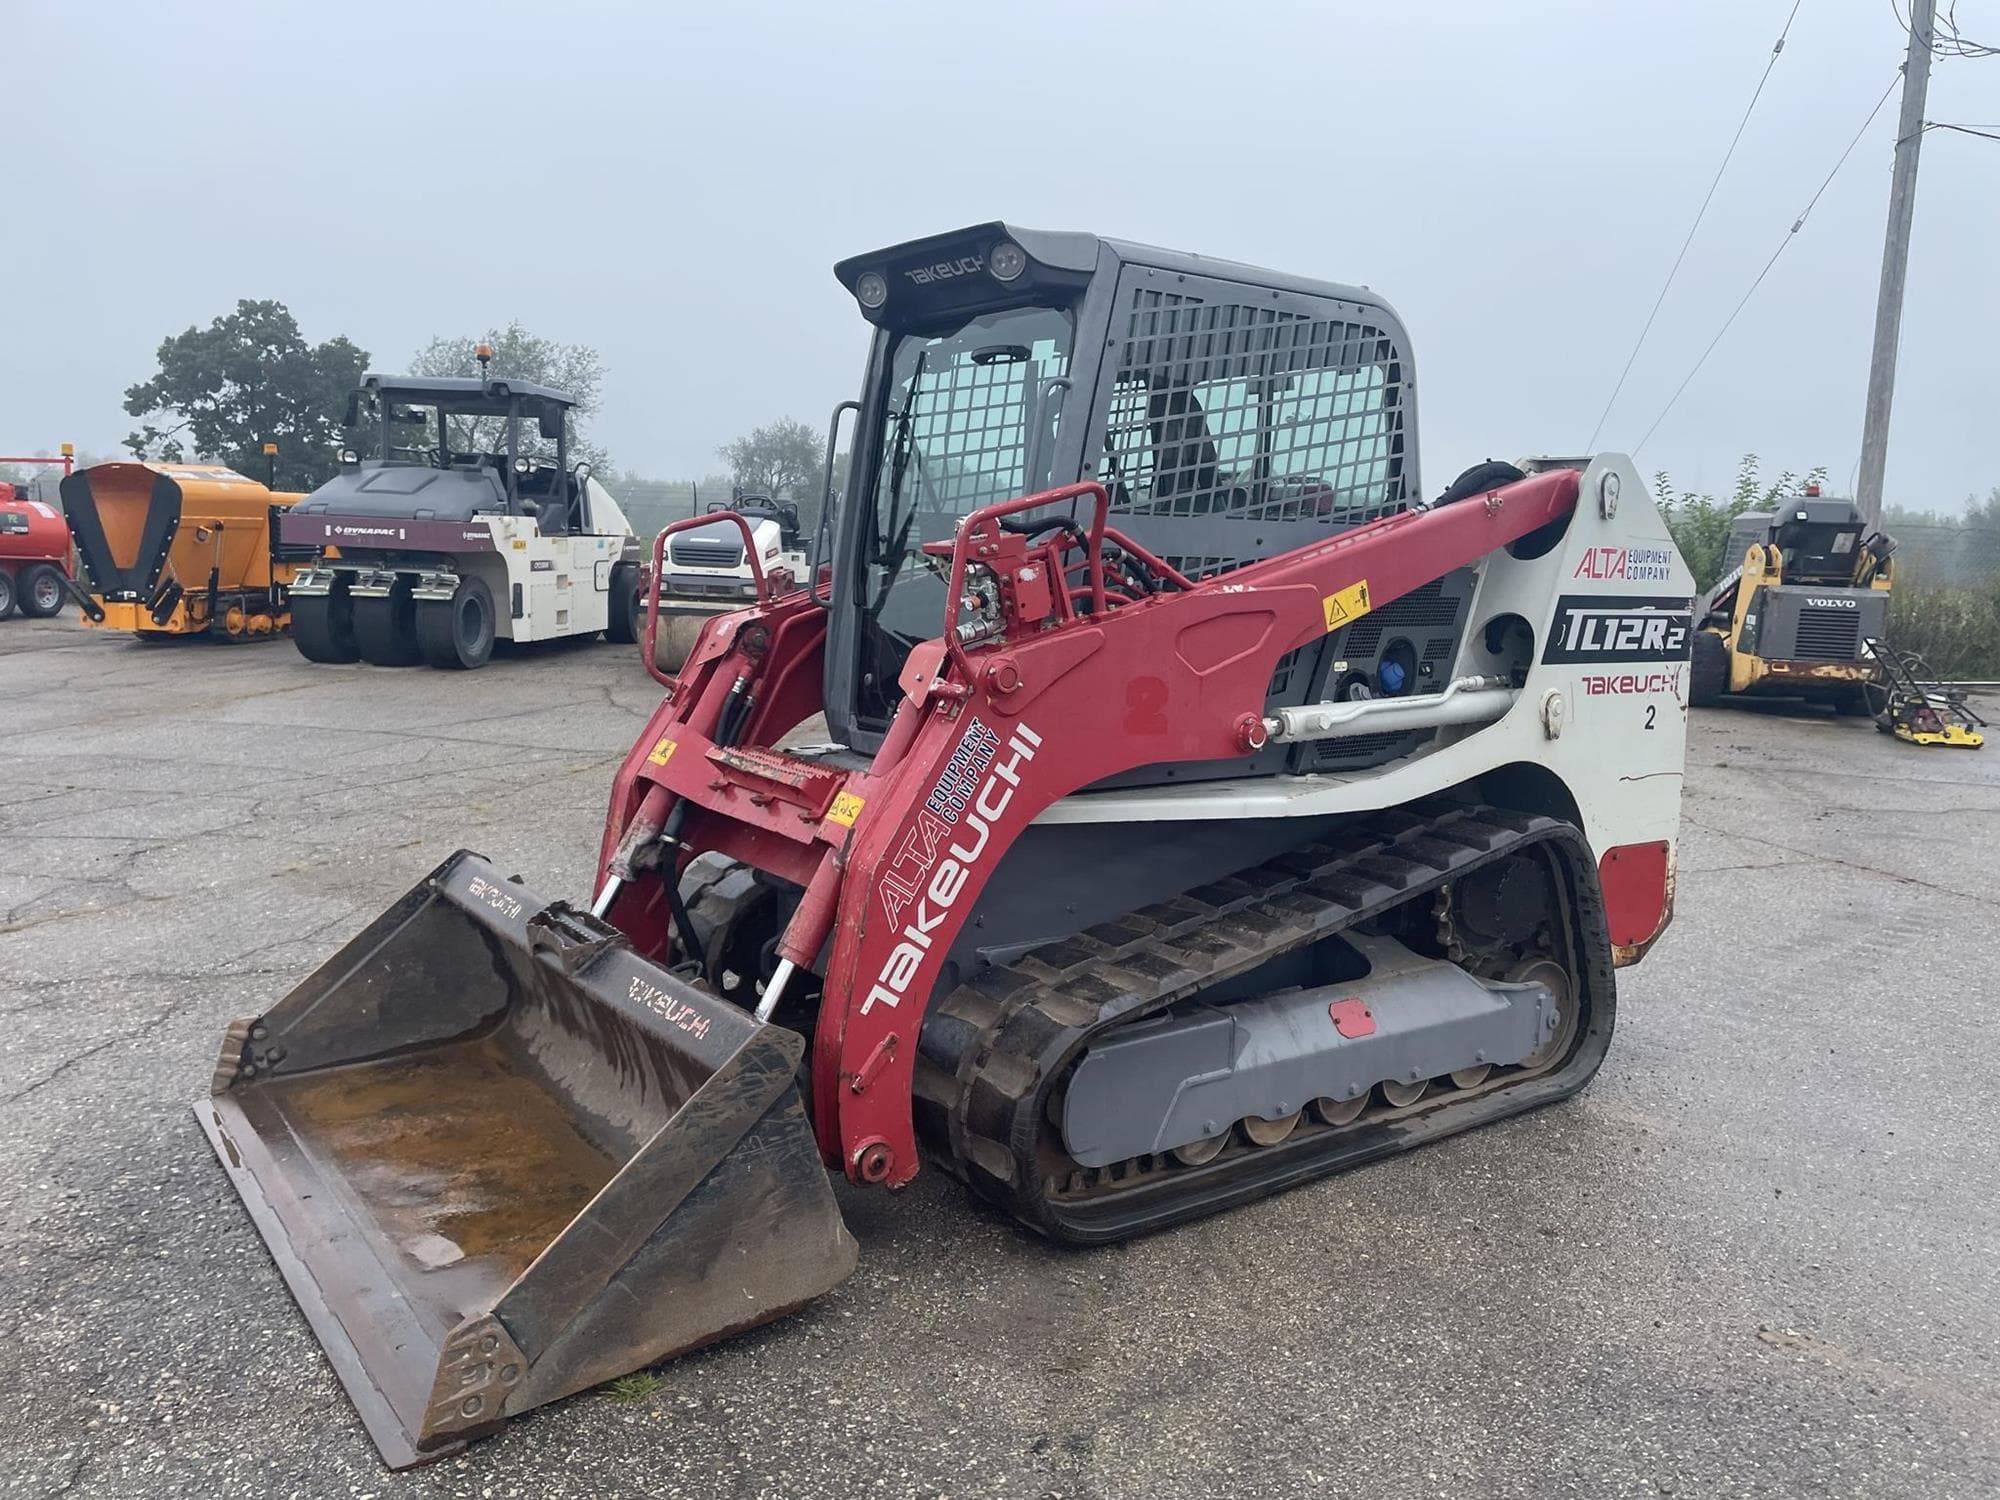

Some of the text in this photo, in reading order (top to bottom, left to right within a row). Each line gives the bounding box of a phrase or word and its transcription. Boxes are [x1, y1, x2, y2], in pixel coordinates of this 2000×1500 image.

[904, 255, 984, 285] TAKEUCH
[343, 527, 395, 535] DYNAPAC
[1573, 547, 1672, 579] ALTA EQUIPMENT
[1626, 566, 1671, 580] COMPANY
[1805, 598, 1856, 608] VOLVO
[1644, 704, 1656, 730] 2
[942, 727, 1001, 826] COMPANY
[878, 716, 987, 935] ALTA EQUIPMENT
[860, 722, 1043, 1016] TAKEUCHI
